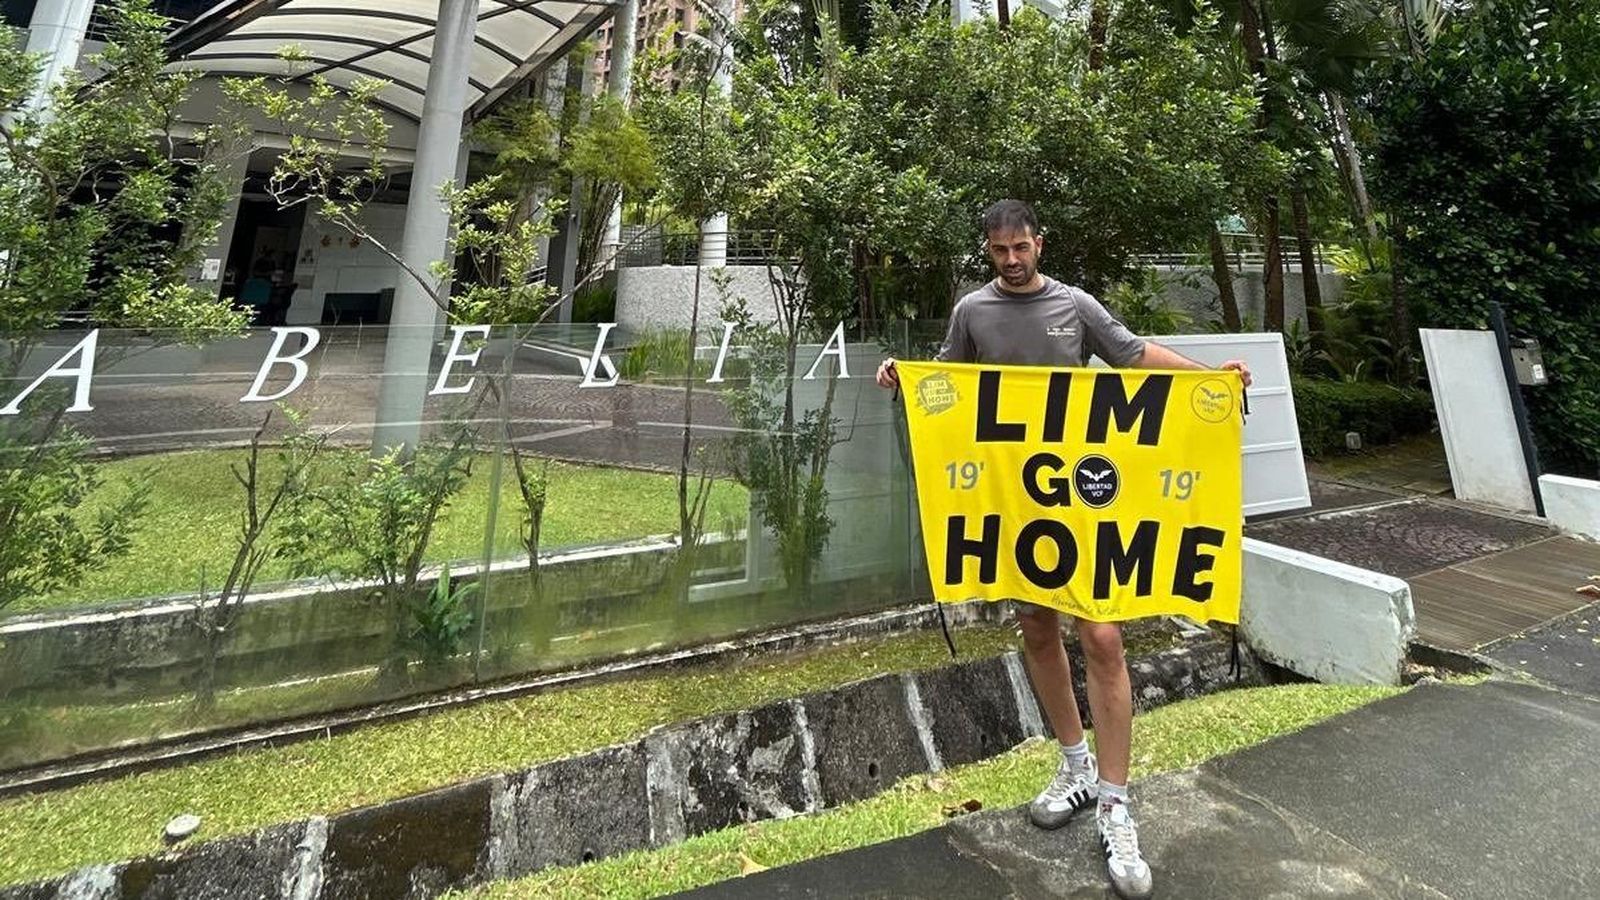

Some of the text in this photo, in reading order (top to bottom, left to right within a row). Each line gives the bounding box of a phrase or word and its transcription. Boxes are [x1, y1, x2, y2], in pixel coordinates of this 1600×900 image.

[0, 321, 851, 415] ABELIA
[976, 370, 1173, 446] LIM
[945, 461, 985, 491] 19'
[1159, 469, 1201, 501] 19'
[945, 514, 1225, 603] HOME
